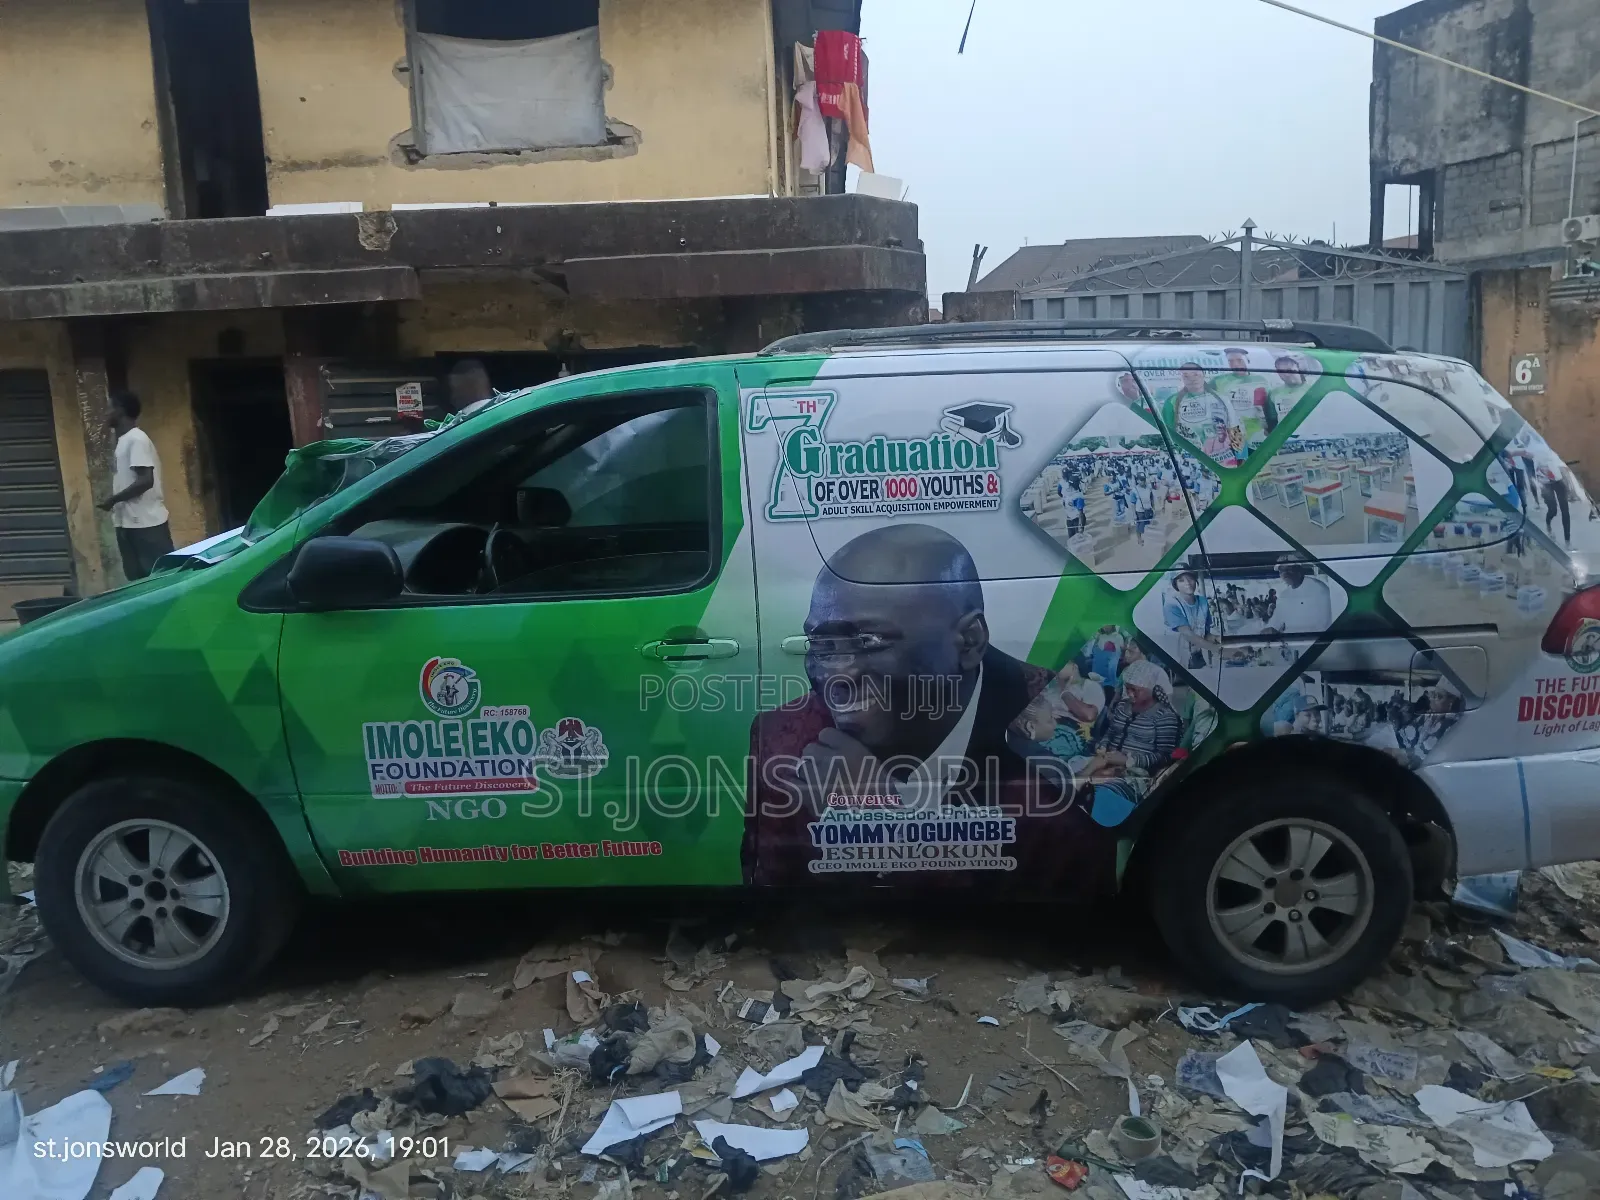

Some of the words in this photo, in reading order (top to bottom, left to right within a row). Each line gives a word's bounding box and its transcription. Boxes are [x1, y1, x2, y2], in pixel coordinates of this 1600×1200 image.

[797, 401, 817, 413] TH
[785, 428, 997, 475] Graduation
[814, 481, 836, 502] OF
[838, 479, 880, 501] OVER
[885, 477, 918, 499] 1000
[920, 475, 984, 497] YOUTHS
[986, 473, 998, 494] &
[822, 505, 848, 516] ADULT
[850, 504, 874, 515] SKILL
[875, 502, 931, 513] ACQUISITION
[933, 499, 998, 512] EMPOWERMENT
[1535, 677, 1567, 694] THE
[483, 709, 498, 717] RC:
[500, 708, 527, 716] 158768
[1518, 692, 1600, 722] DISCOV
[1533, 723, 1566, 738] Light
[1568, 720, 1582, 732] of
[365, 723, 463, 760] IMOLE
[470, 719, 534, 756] EKO
[370, 758, 534, 780] FOUNDATION
[410, 782, 431, 792] The
[433, 781, 472, 792] Future
[474, 779, 532, 791] Discovery
[827, 793, 901, 806] Convener
[425, 797, 507, 821] NGO
[942, 806, 1000, 819] Prince
[811, 823, 900, 845] YOMMY
[905, 820, 1013, 844] OGUNGBE
[338, 849, 418, 866] Building
[419, 845, 508, 863] Humanity
[511, 843, 539, 860] for
[540, 841, 599, 859] Better
[601, 839, 663, 857] Future
[846, 861, 888, 869] IMOLE
[891, 861, 917, 869] EKO
